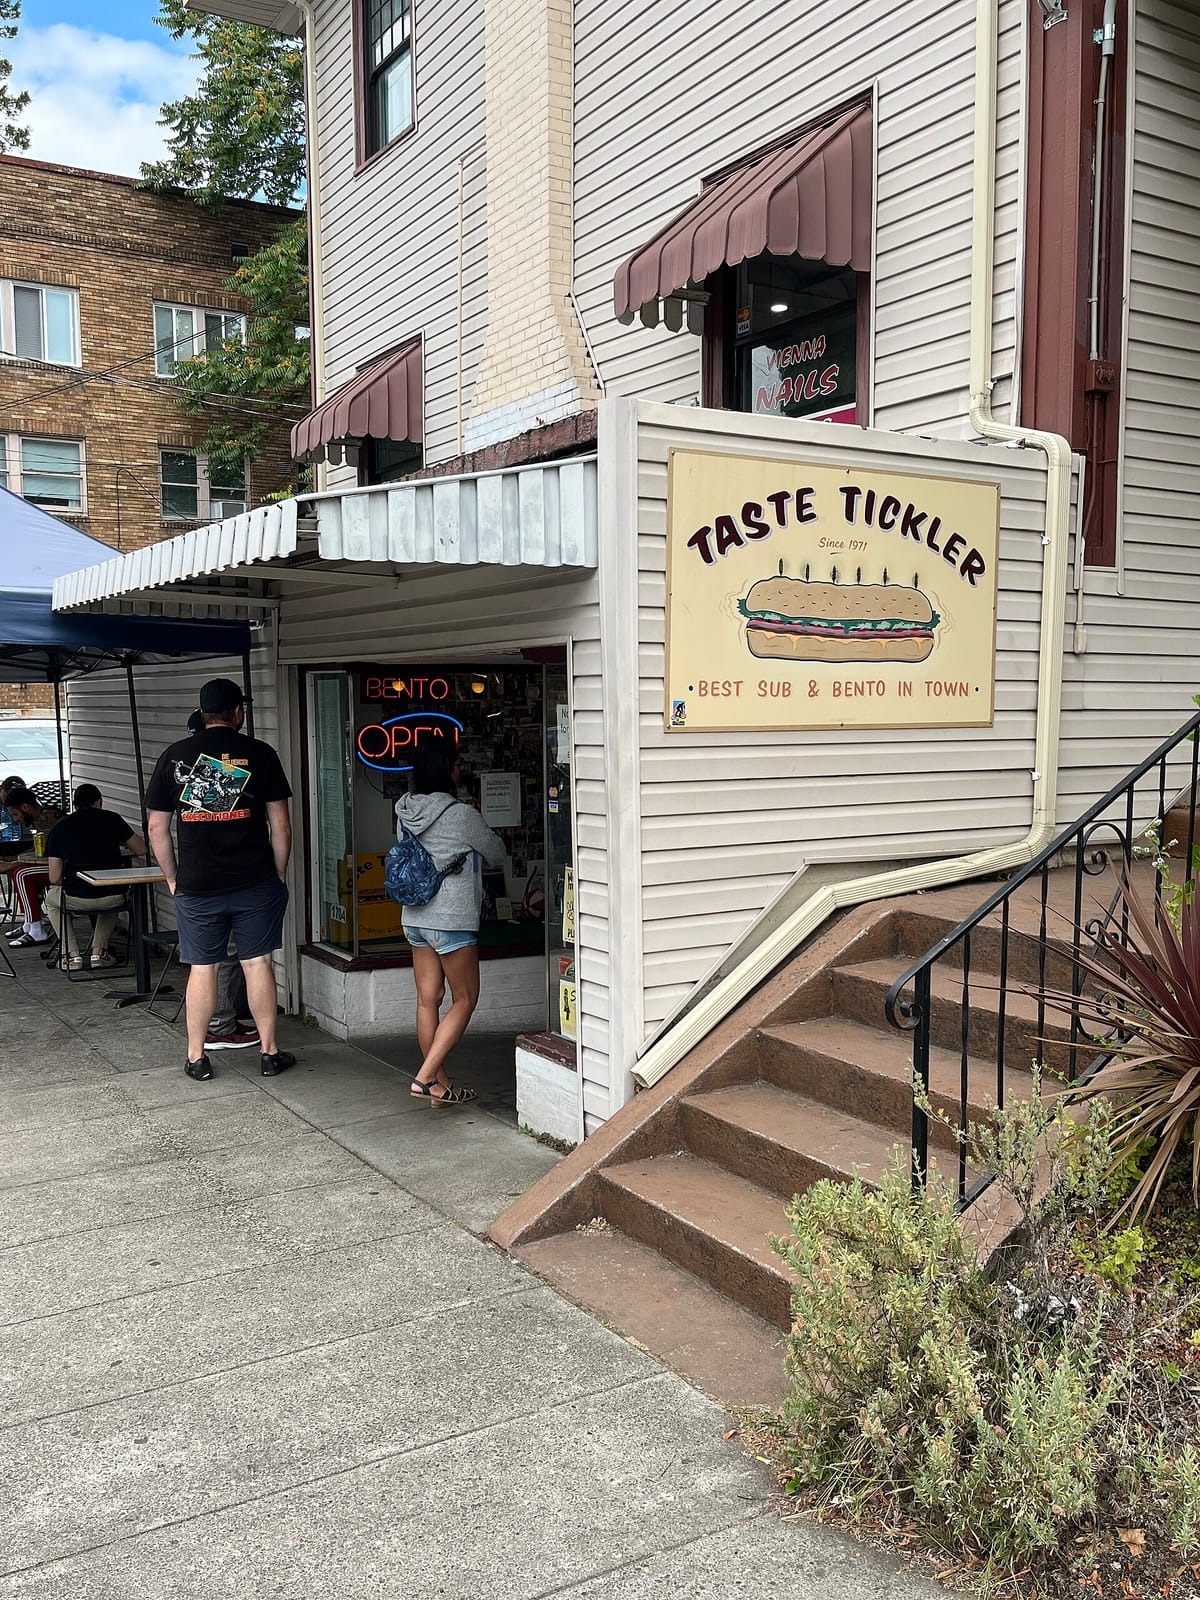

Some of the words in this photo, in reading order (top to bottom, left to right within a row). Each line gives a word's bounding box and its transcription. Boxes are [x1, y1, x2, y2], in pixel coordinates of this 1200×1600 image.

[767, 335, 826, 370] VIENNA
[756, 364, 840, 412] NAILS
[687, 487, 819, 565] TASTE
[838, 486, 986, 588] TICKLER
[817, 536, 846, 549] Since
[848, 539, 868, 551] 1971
[366, 677, 449, 700] BENTO
[698, 680, 743, 697] BEST
[757, 680, 791, 697] SUB
[808, 679, 820, 697] &
[832, 680, 886, 697] BENTO
[898, 681, 912, 697] IN
[924, 681, 969, 697] TOWN
[182, 809, 250, 822] EXECUTIONER
